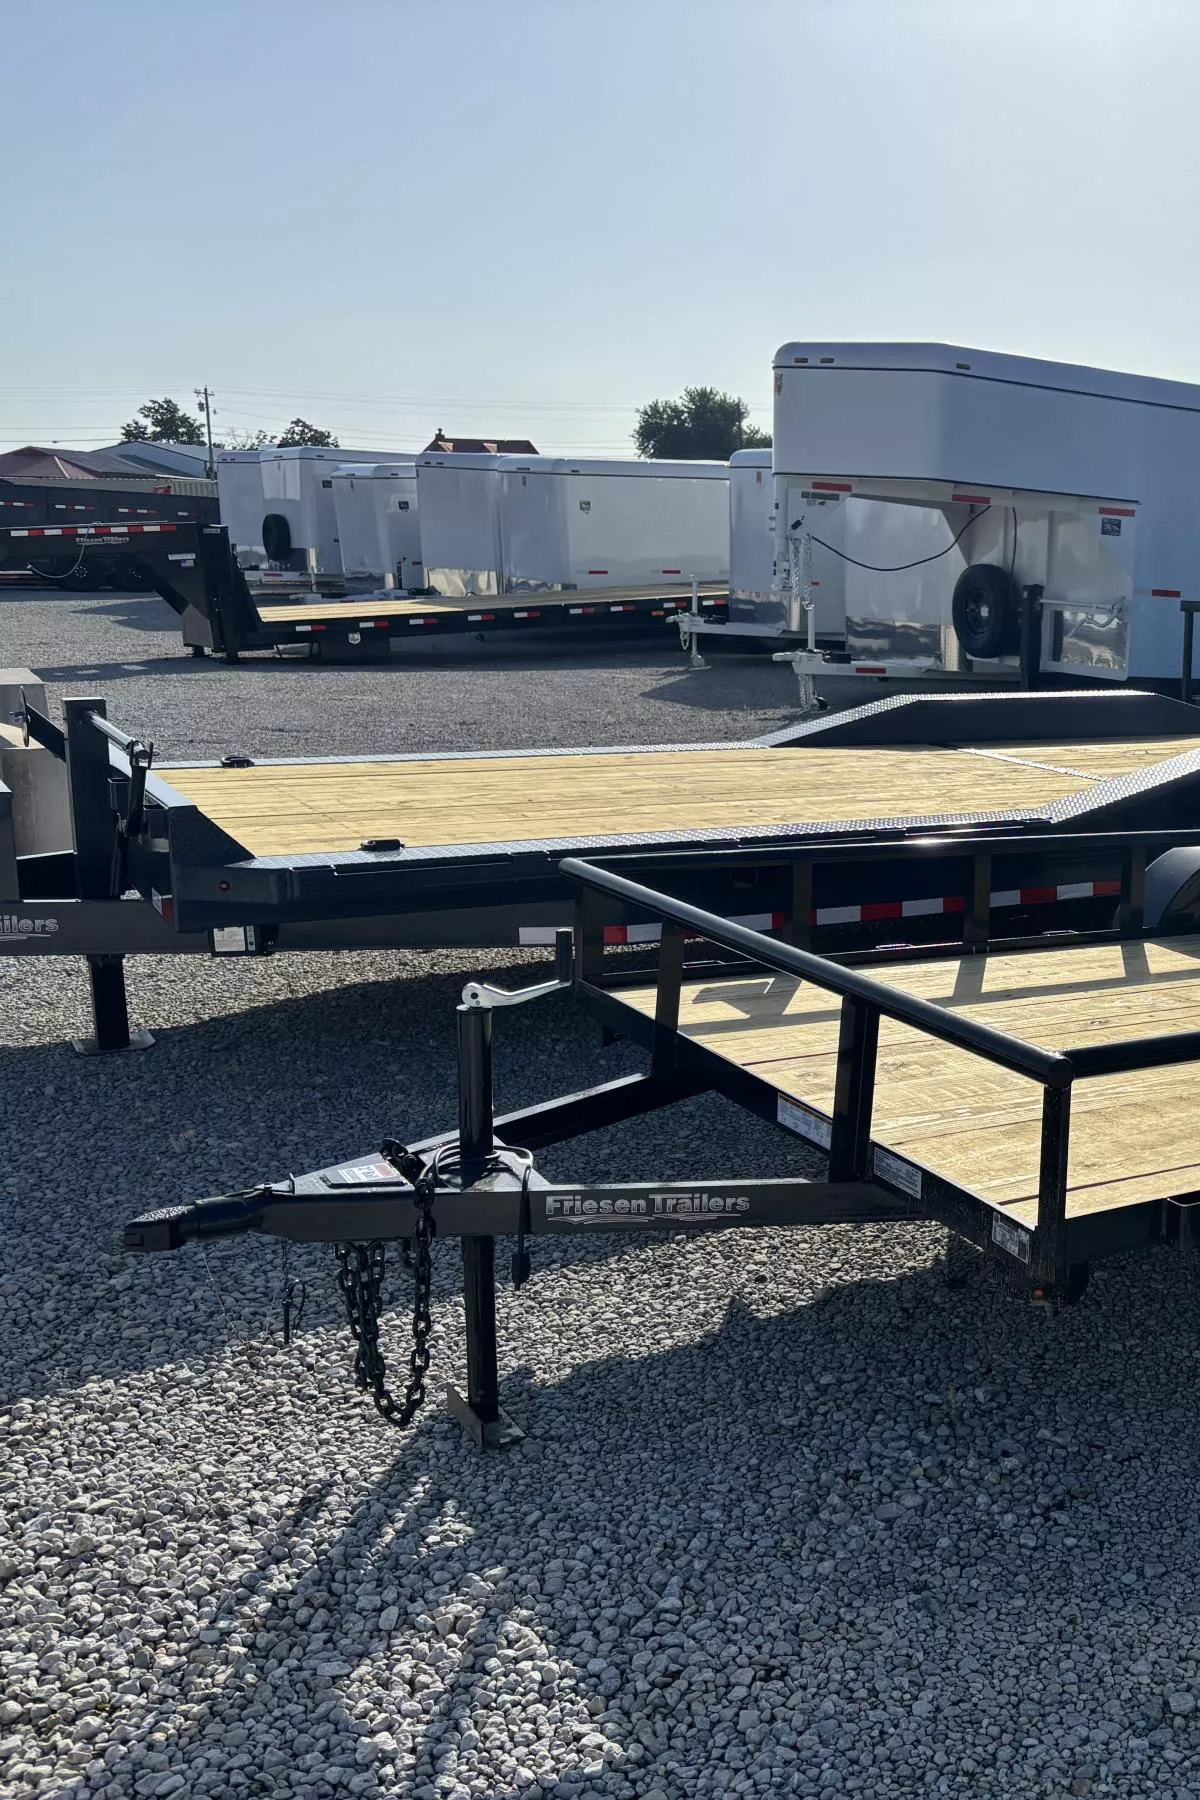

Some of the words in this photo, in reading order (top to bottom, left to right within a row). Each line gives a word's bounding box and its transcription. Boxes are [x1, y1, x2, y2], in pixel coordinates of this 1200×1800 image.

[0, 915, 59, 932] ilers
[545, 1195, 647, 1215] Friesen
[648, 1193, 750, 1213] Trailers
